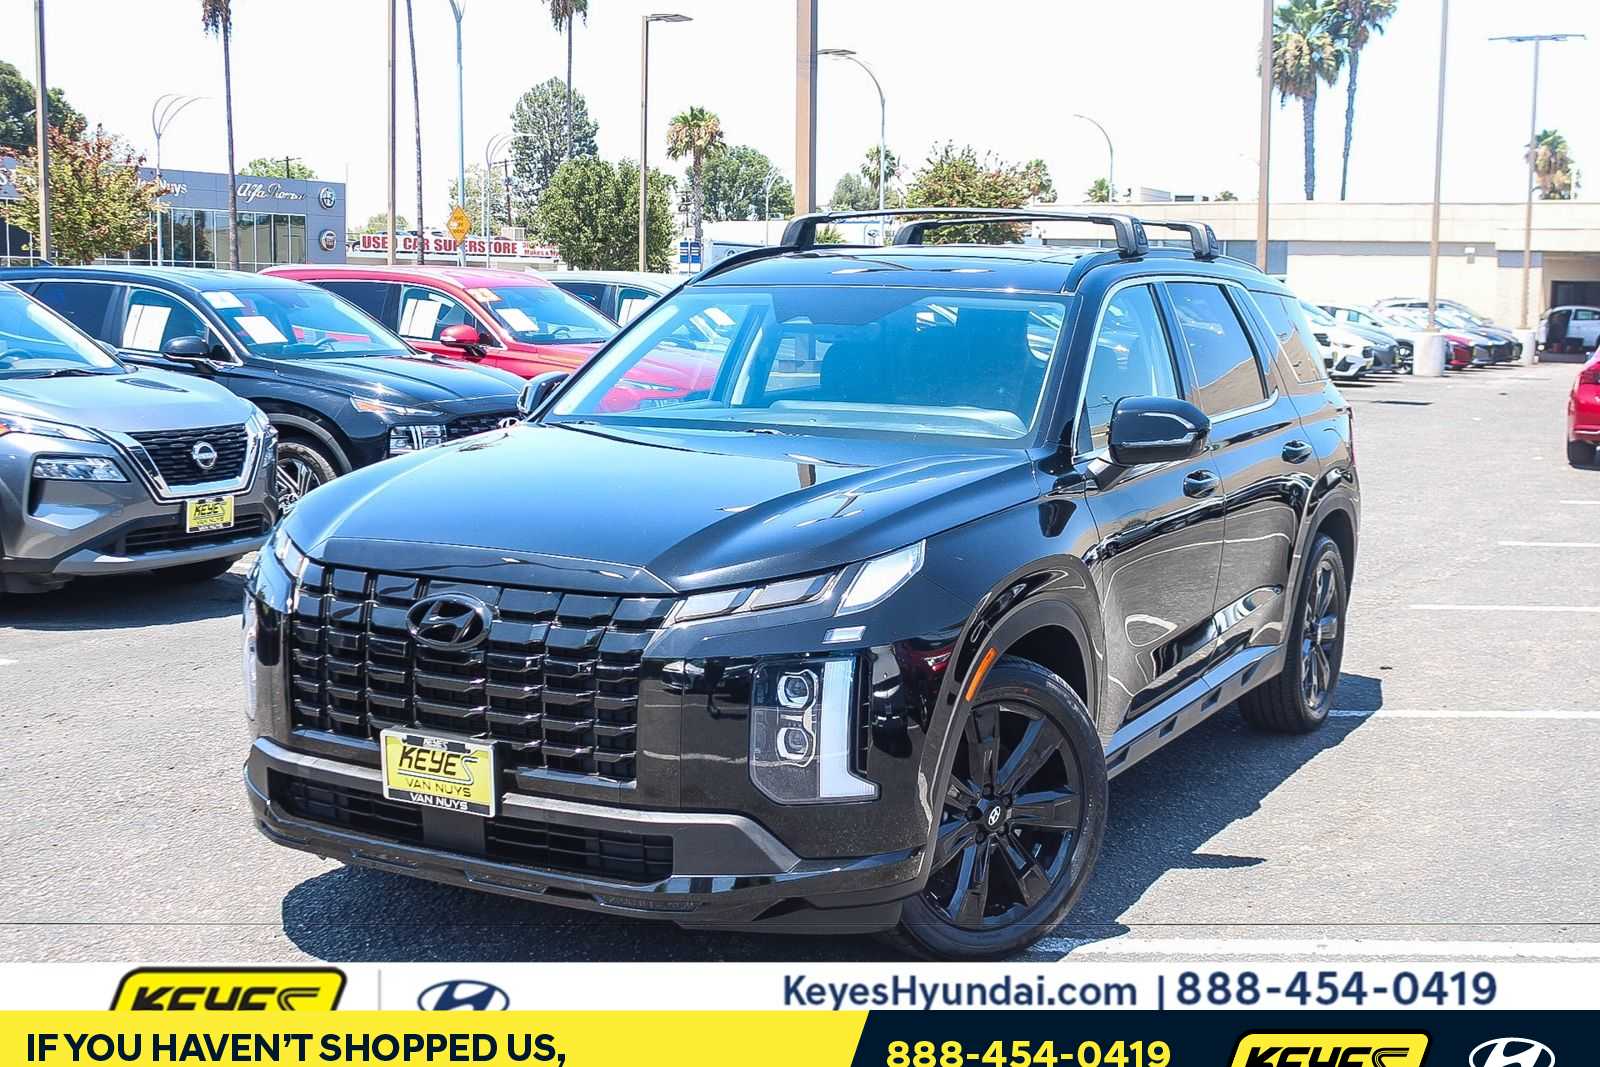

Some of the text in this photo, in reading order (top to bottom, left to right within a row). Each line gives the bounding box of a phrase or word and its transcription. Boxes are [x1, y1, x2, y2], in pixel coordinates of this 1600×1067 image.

[237, 183, 267, 203] Alfa
[362, 236, 398, 250] USE
[403, 237, 430, 251] CAR
[398, 746, 479, 781] KEYES
[406, 778, 472, 798] VAN NUYS
[410, 792, 468, 811] VAN NUYS
